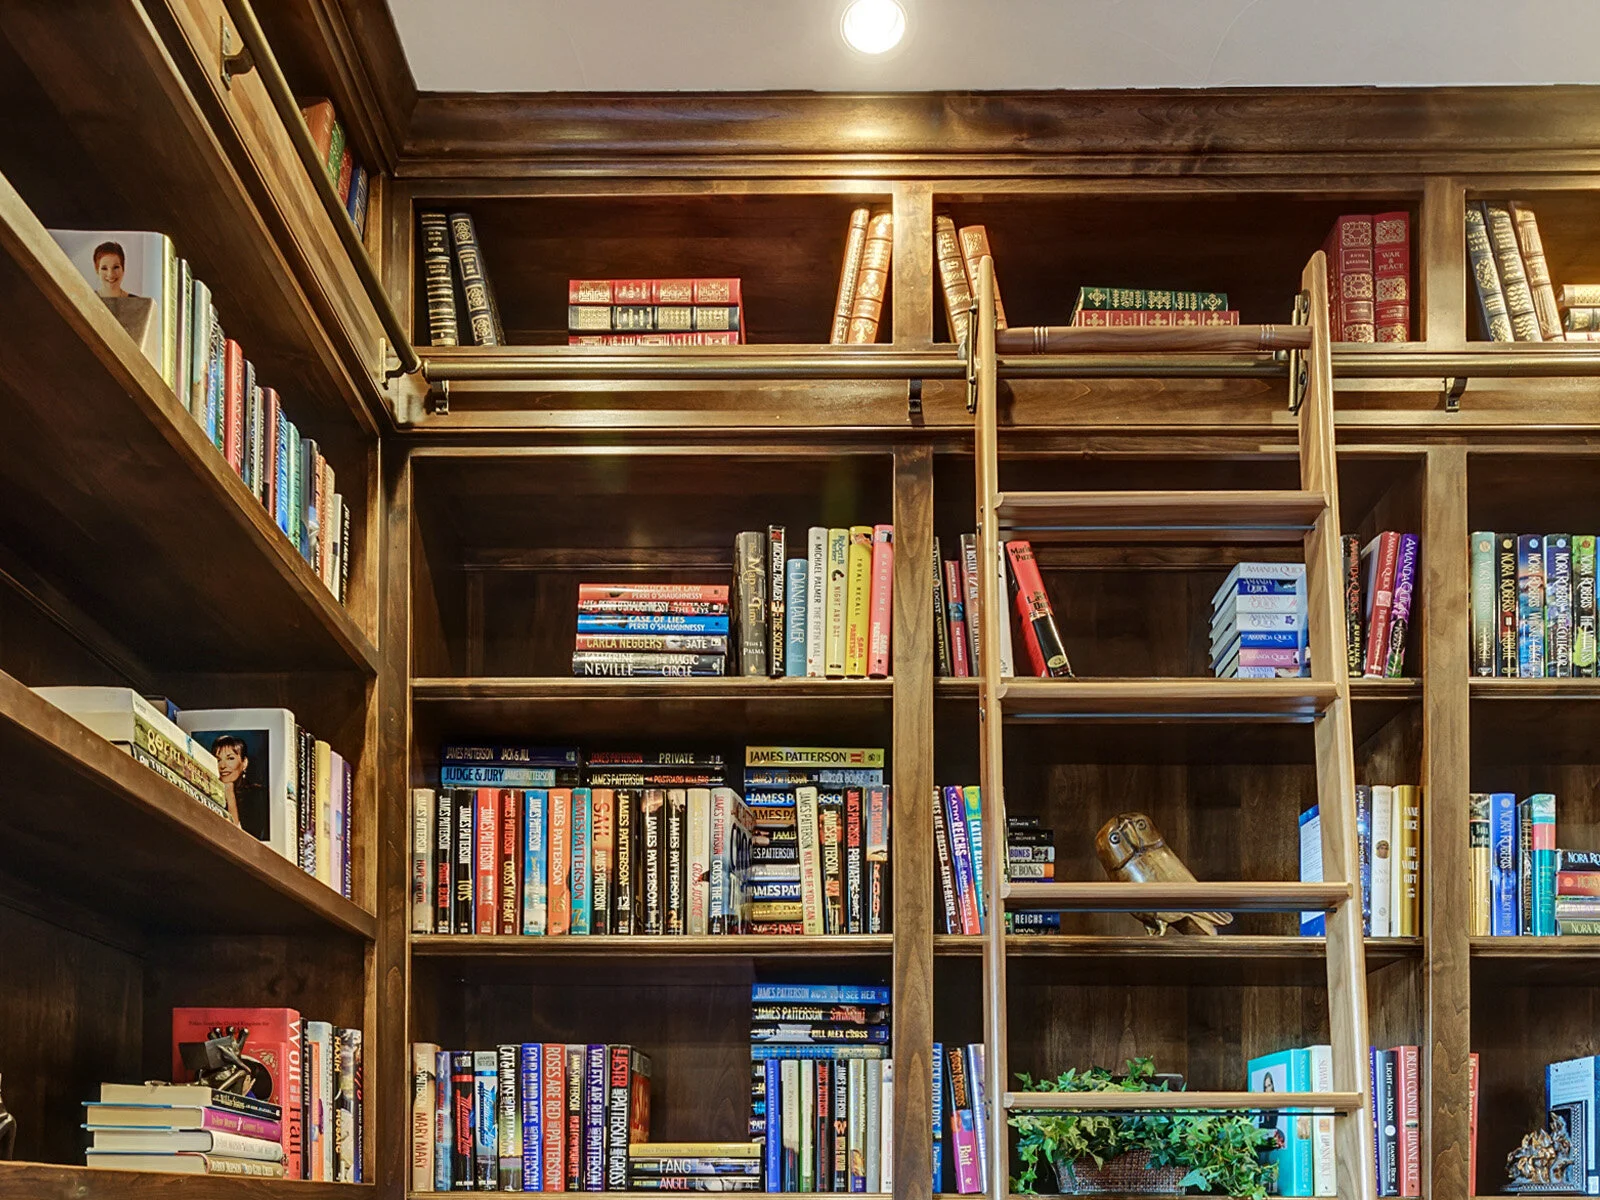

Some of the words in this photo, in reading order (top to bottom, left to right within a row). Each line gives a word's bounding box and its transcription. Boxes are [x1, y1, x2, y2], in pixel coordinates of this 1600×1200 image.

[789, 573, 806, 604] DIANA
[789, 606, 806, 644] PALMER
[586, 638, 617, 649] CARLA
[619, 638, 663, 649] NEGGERS
[584, 663, 634, 677] NEVILLE
[661, 665, 692, 677] CIRCLE
[669, 655, 699, 666] MAGIC
[659, 752, 695, 764] PRIVATE
[750, 752, 784, 763] JAMES
[786, 752, 847, 763] PATTERSON
[439, 795, 451, 817] JAMES
[460, 806, 473, 828] JAMES
[481, 806, 495, 832] JAMES
[553, 795, 565, 826] JAMES
[575, 794, 588, 832] JAMES
[618, 793, 630, 826] JAMES
[950, 793, 961, 821] KATHY
[439, 818, 451, 850] PATTERSON
[594, 802, 610, 842] SAIL
[648, 816, 658, 847] JAMES
[669, 817, 681, 849] JAMES
[1500, 811, 1513, 833] NORA
[460, 828, 472, 864] PATTERSON
[480, 832, 495, 870] PATTERSON
[951, 820, 968, 857] REICHS
[553, 828, 564, 886] PATTERSON
[574, 832, 587, 900] PATTERSON
[618, 827, 630, 886] PATTERSON
[1567, 852, 1589, 863] NORA
[647, 849, 658, 908] PATTERSON
[669, 850, 680, 909] PATTERSON
[711, 860, 723, 884] CROSS
[457, 879, 473, 901] TOYS
[711, 885, 723, 900] THE
[711, 901, 722, 918] LINE
[1014, 913, 1043, 925] REICHS
[546, 1046, 561, 1078] ROSES
[612, 1054, 628, 1087] JESTER
[1406, 1051, 1418, 1080] DREAM
[546, 1079, 561, 1098] ARE
[1406, 1080, 1419, 1117] COUNTRY
[523, 1101, 538, 1124] MICE
[546, 1100, 560, 1120] RED
[610, 1096, 627, 1147] PATTERSON
[414, 1111, 429, 1138] MARY
[414, 1141, 428, 1169] MARY
[522, 1134, 538, 1183] PATTERSON
[546, 1129, 561, 1185] PATTERSON
[659, 1159, 692, 1174] FANG
[958, 1144, 972, 1166] Bait
[610, 1155, 627, 1185] GROSS
[659, 1177, 690, 1191] ANGEL
[1407, 1164, 1418, 1182] RICE
